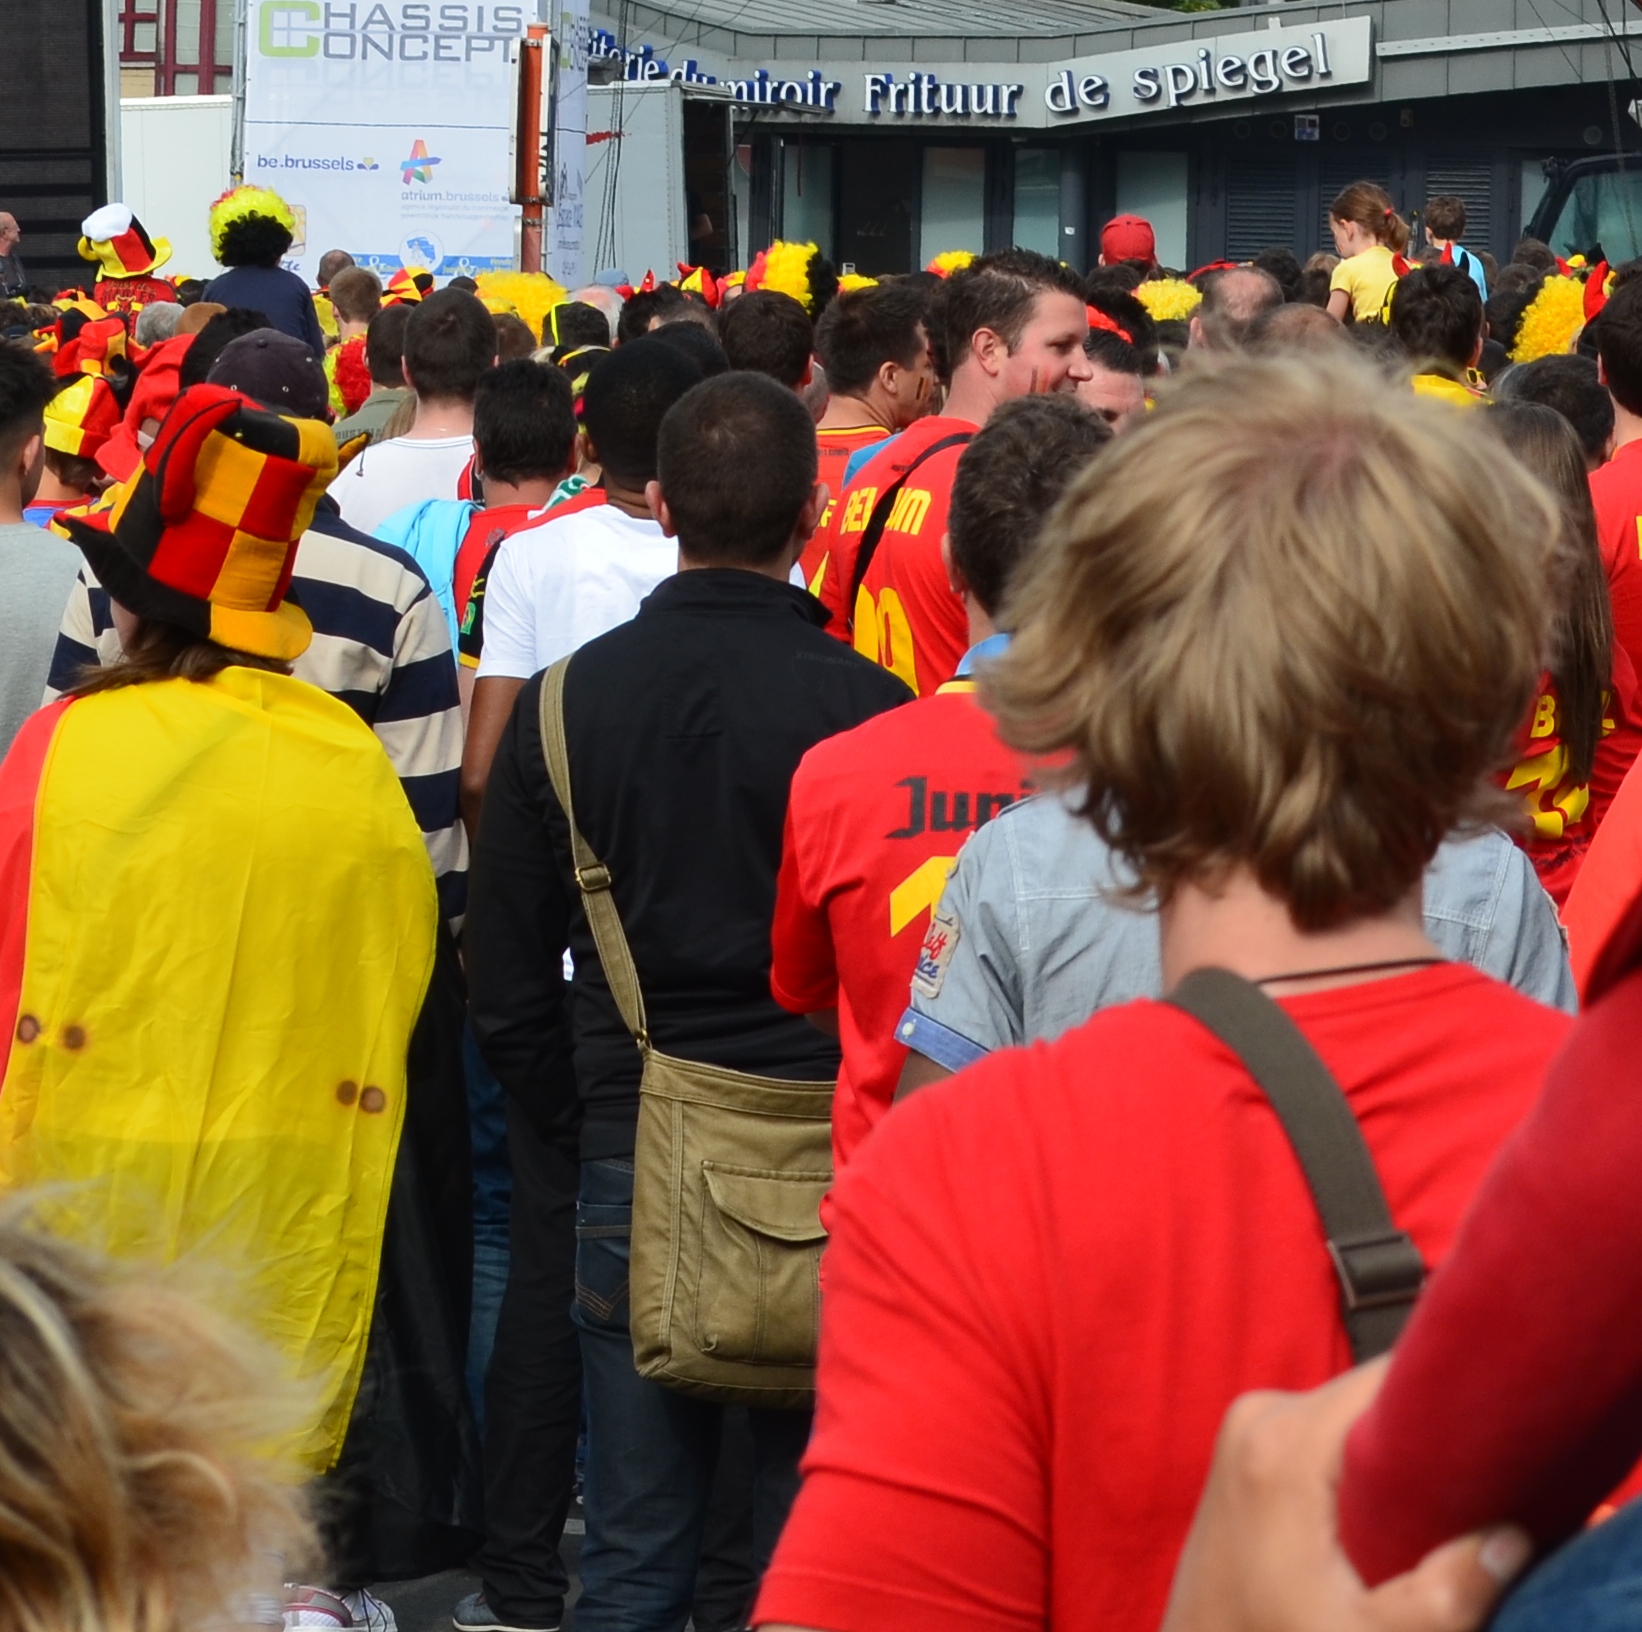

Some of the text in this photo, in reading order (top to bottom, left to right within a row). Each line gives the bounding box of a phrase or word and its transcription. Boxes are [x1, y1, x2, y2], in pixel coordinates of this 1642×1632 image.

[864, 72, 1024, 116] Frituur
[1045, 70, 1110, 116] de
[1134, 31, 1332, 109] spiegel
[401, 189, 500, 203] atrium.brussels
[839, 486, 932, 536] BELUM
